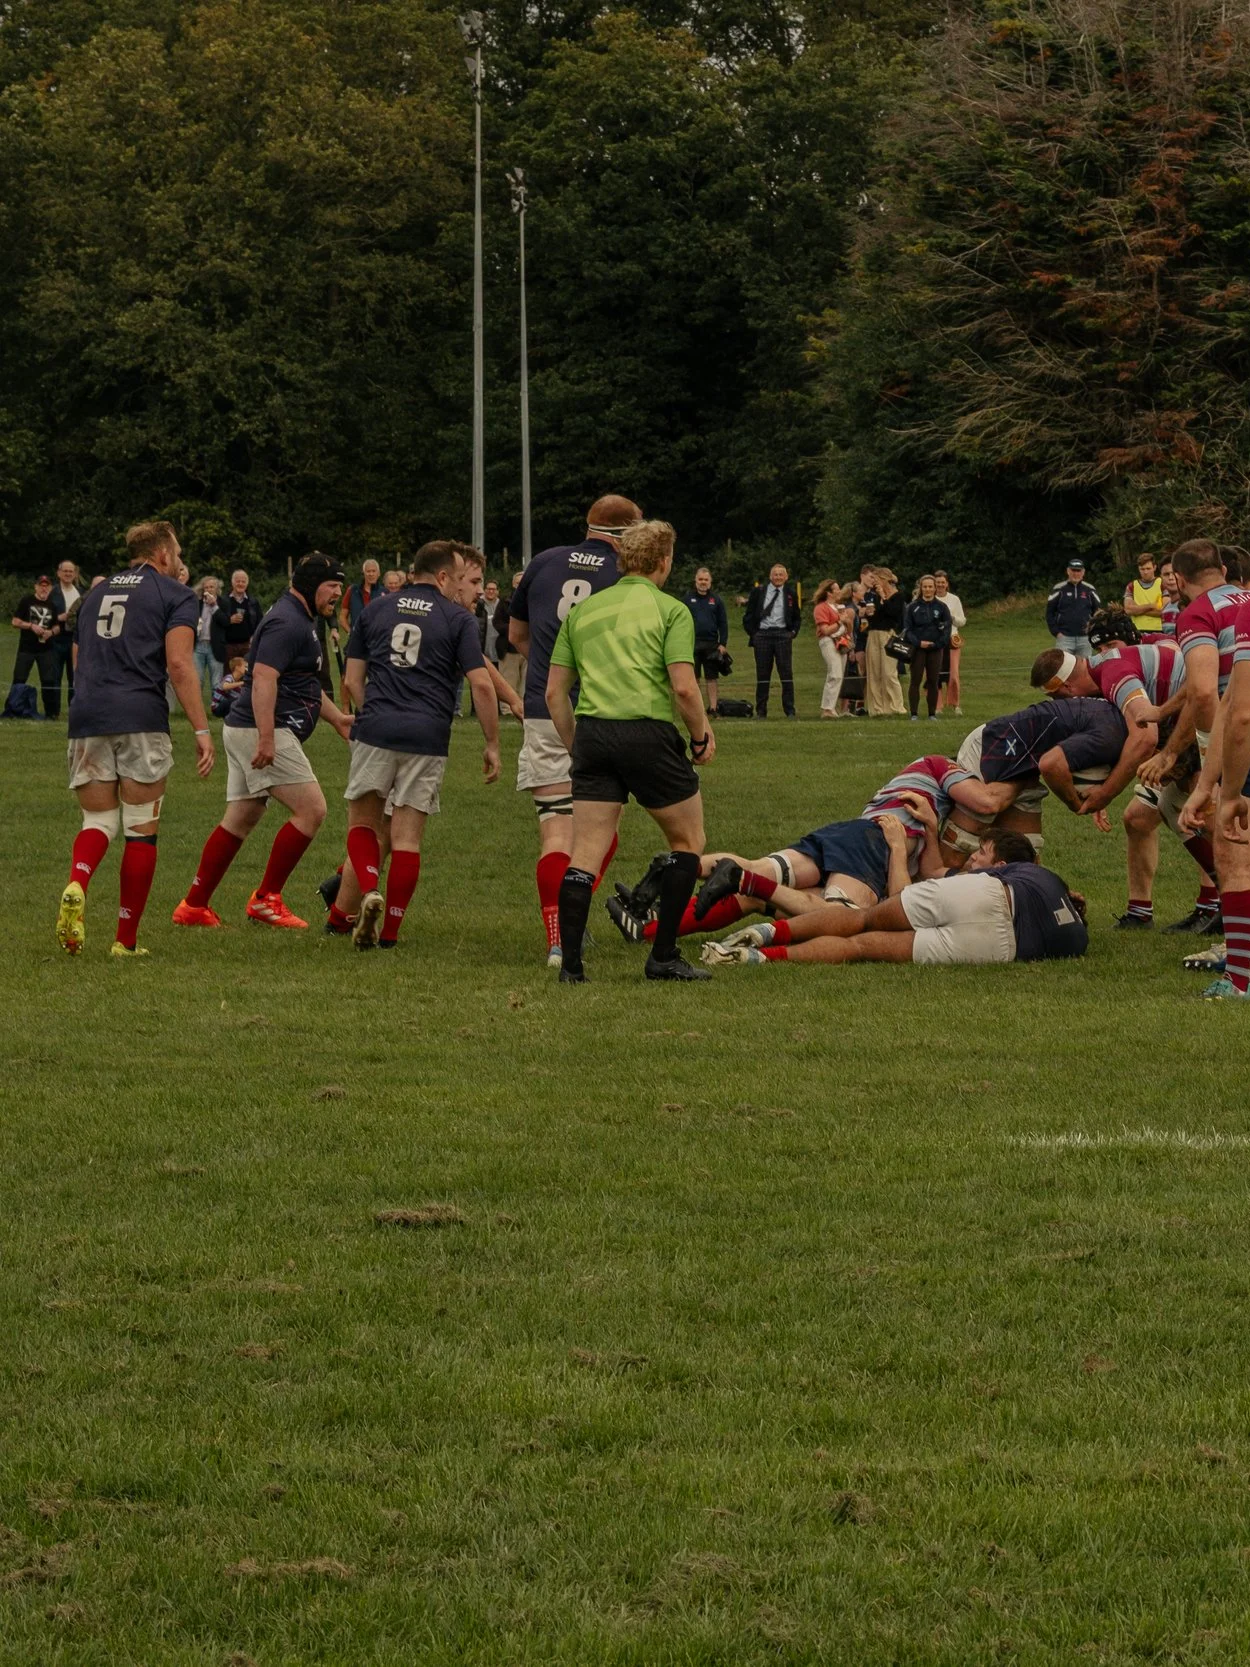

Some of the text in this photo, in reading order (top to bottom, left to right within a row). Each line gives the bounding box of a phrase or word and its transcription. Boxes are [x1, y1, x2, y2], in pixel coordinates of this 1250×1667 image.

[568, 551, 606, 566] Stiltz
[109, 574, 145, 585] Stiltz
[397, 597, 434, 612] Stiltz
[557, 579, 592, 623] 8
[96, 594, 129, 639] 5
[390, 622, 422, 668] 9
